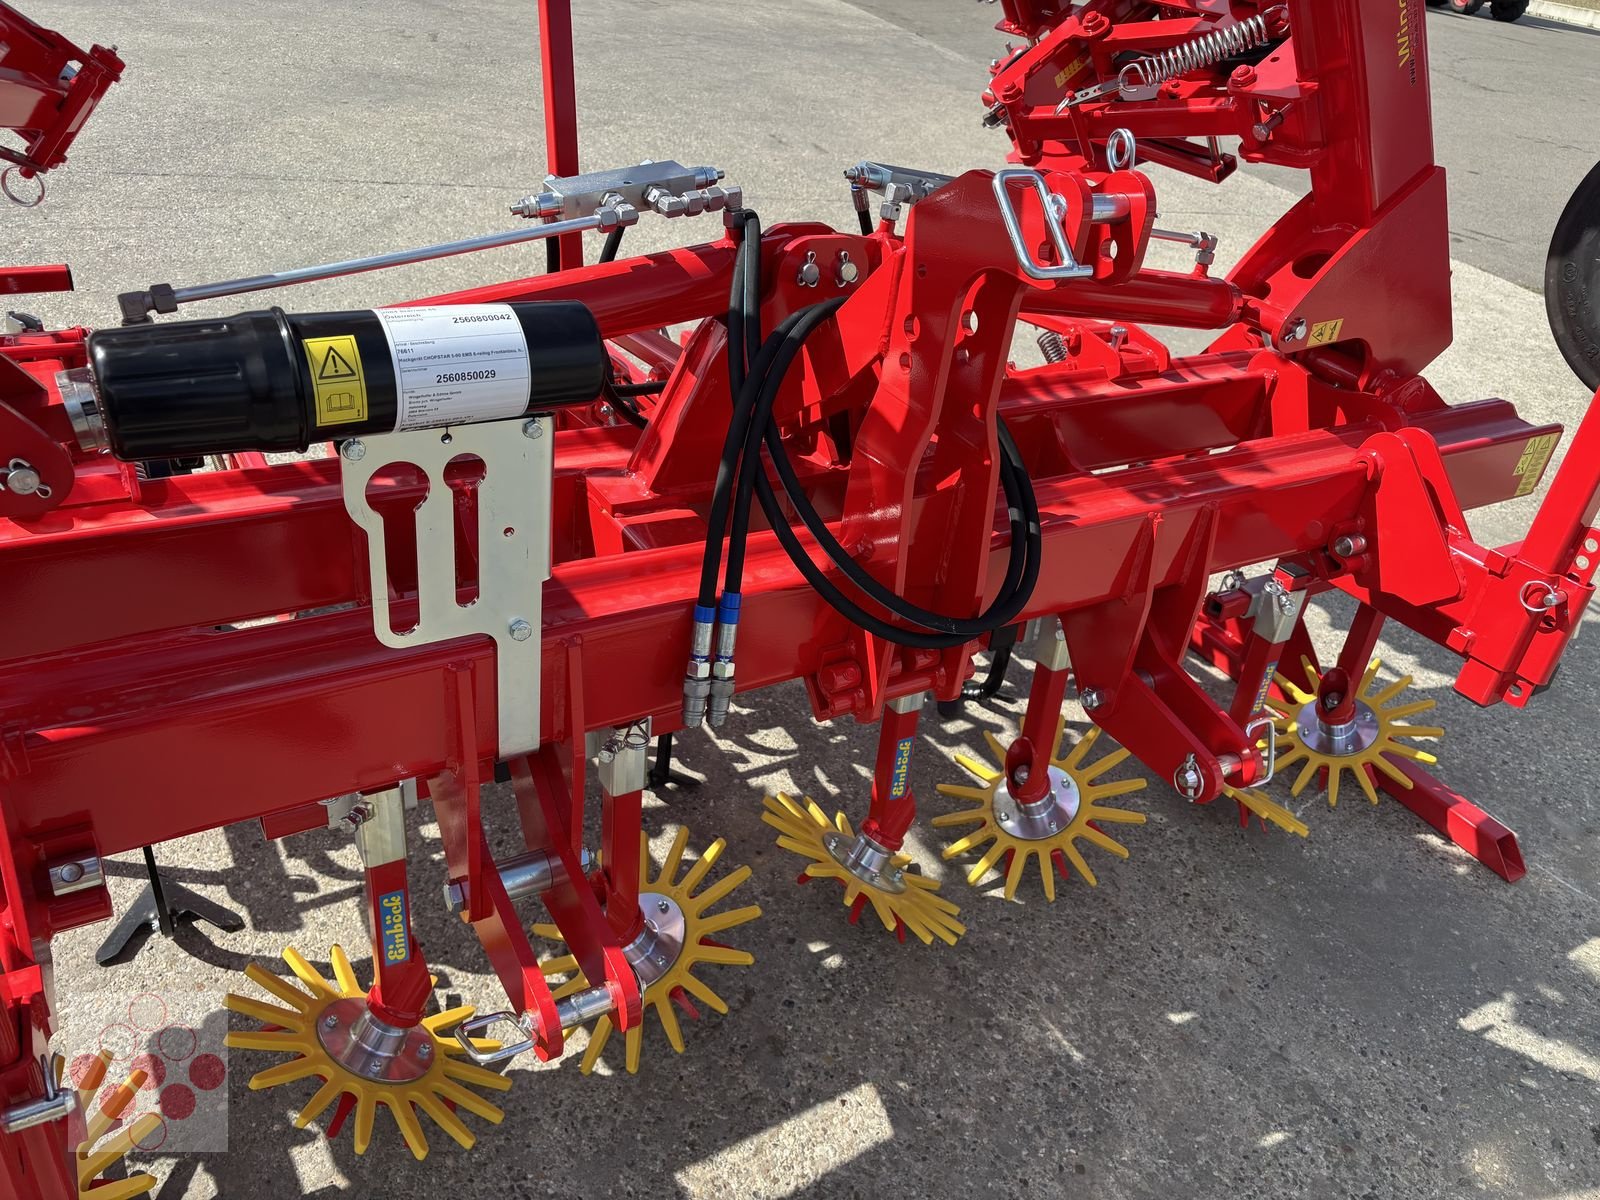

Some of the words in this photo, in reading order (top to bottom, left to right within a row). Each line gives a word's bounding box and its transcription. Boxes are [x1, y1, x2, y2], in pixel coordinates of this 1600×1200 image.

[452, 313, 512, 324] 2560800042
[436, 369, 496, 384] 2560850029
[891, 741, 911, 797] Einböck
[383, 895, 407, 961] Einböck
